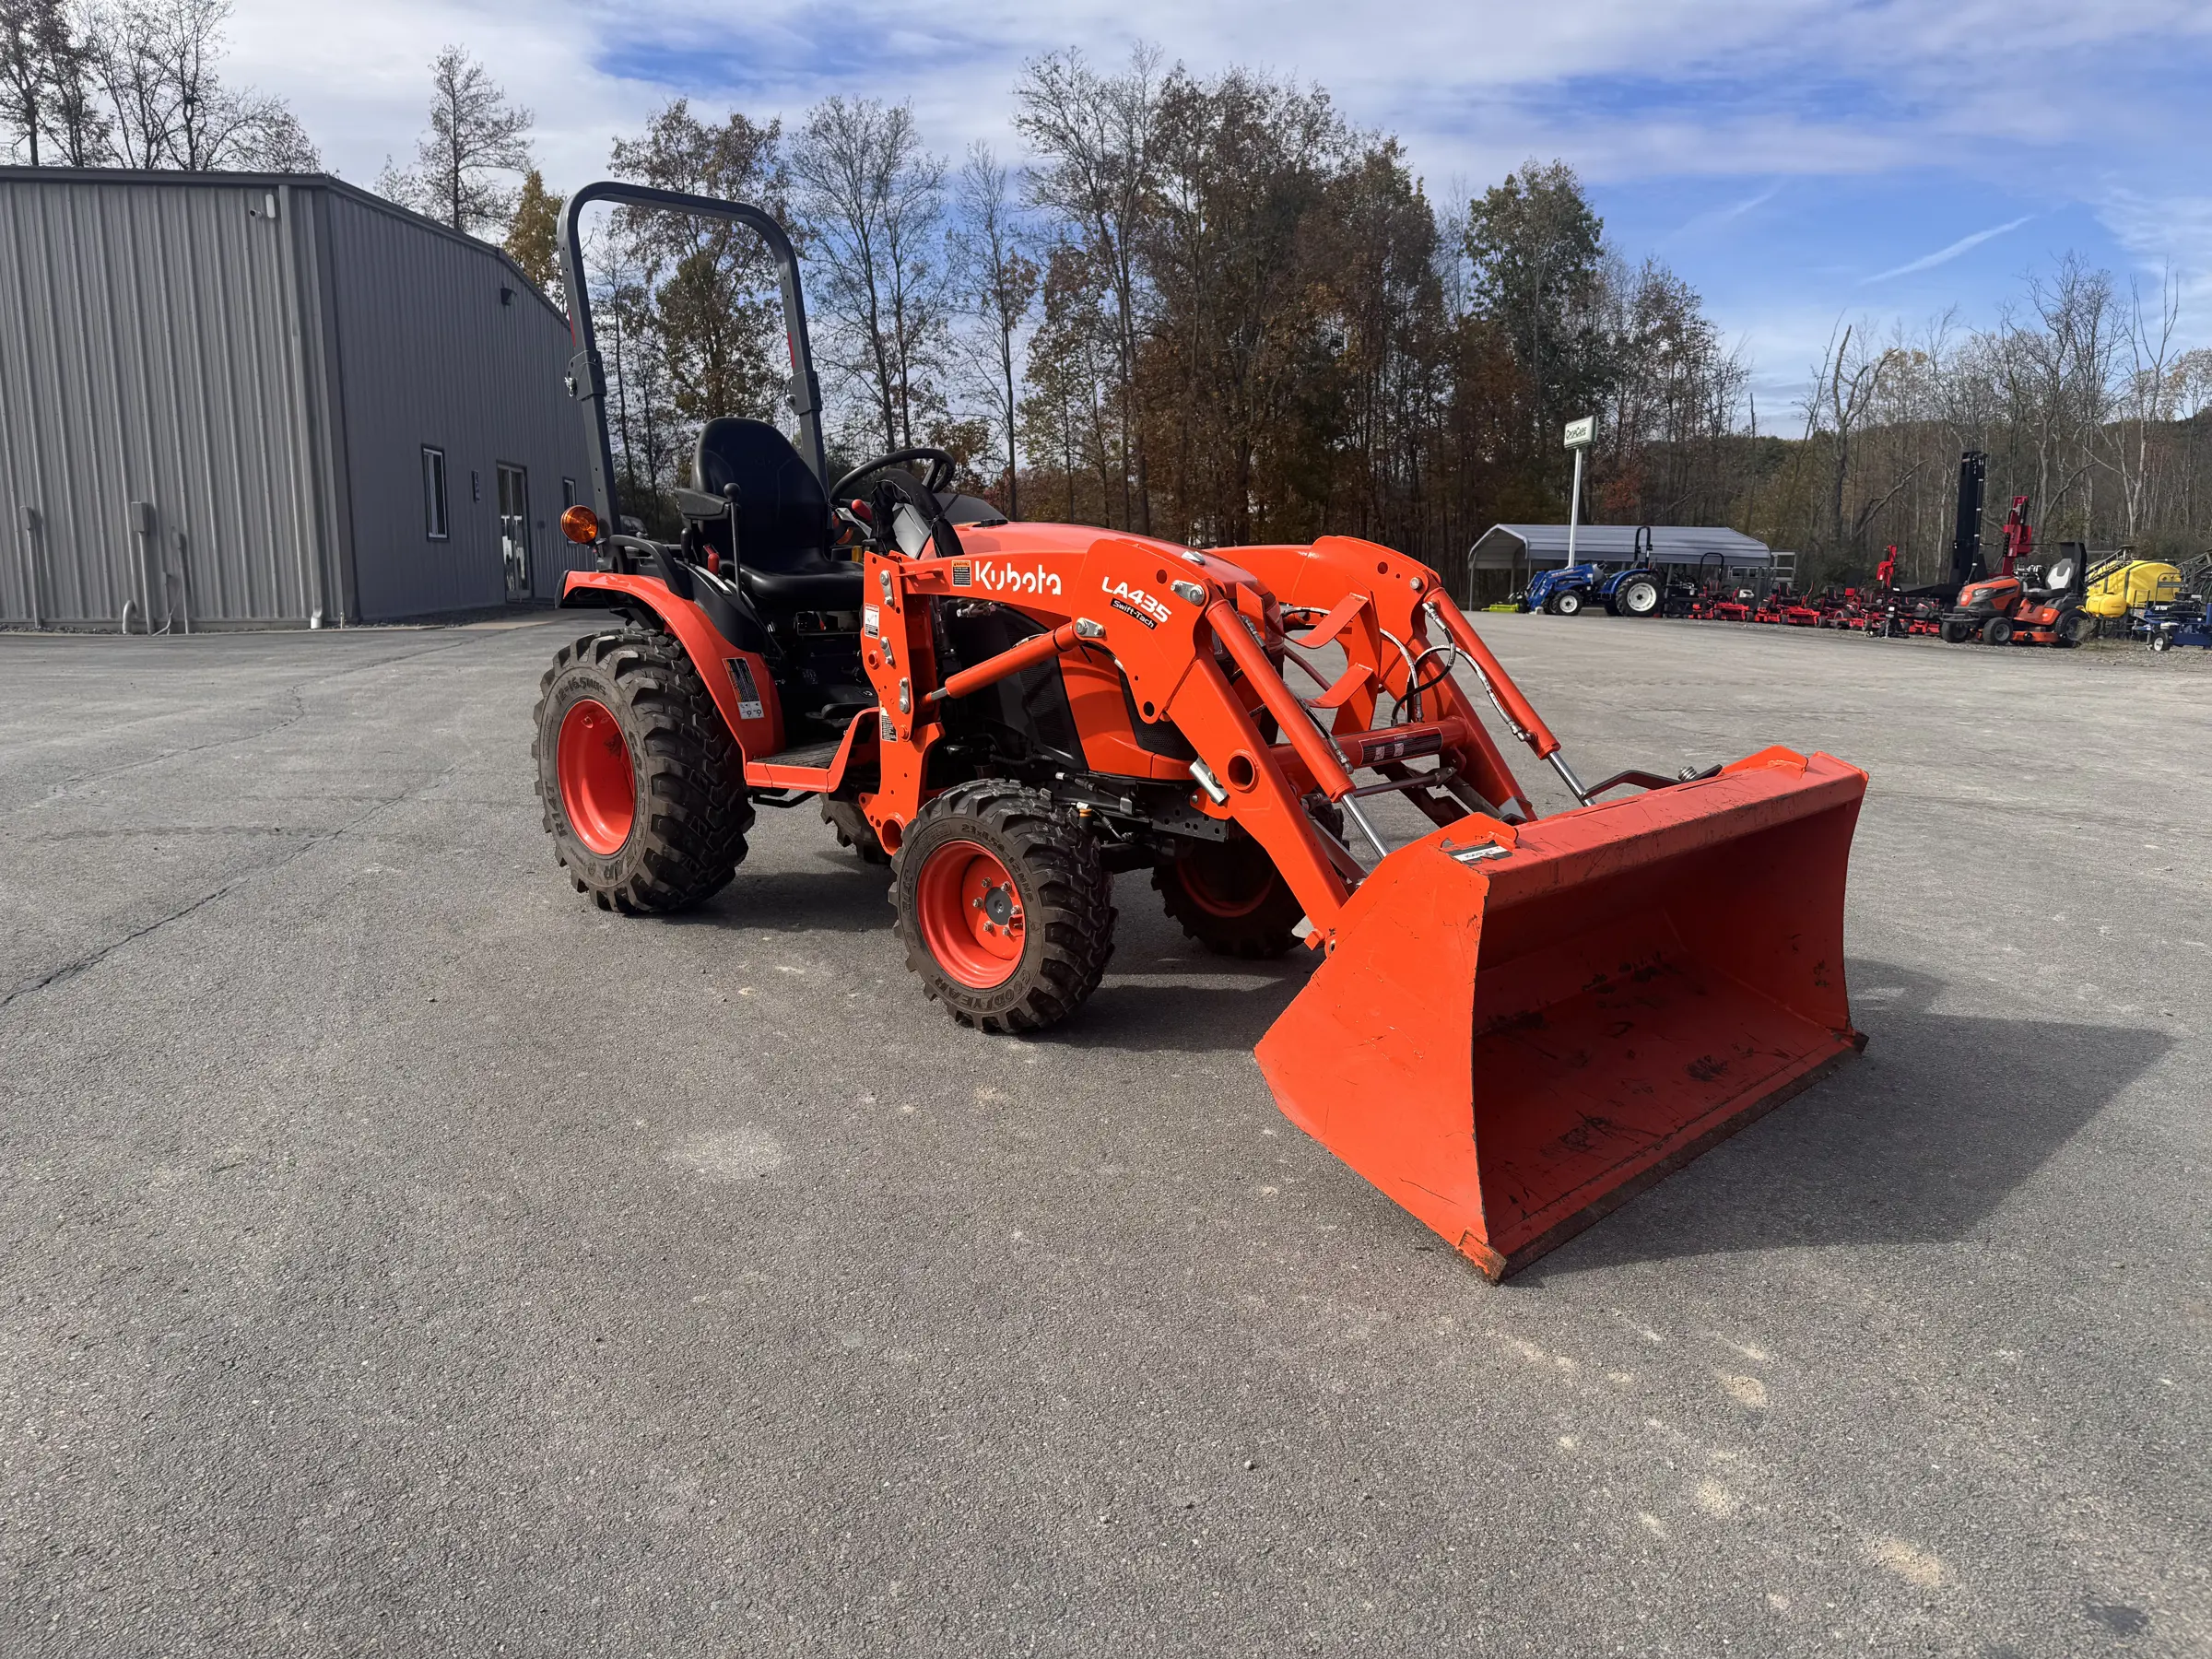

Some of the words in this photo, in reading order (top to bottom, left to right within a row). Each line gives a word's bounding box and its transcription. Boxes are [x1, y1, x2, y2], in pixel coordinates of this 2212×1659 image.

[975, 560, 1062, 595] Kubota
[1101, 576, 1172, 623] LA435
[1112, 600, 1155, 629] Swift-Tach
[934, 968, 1030, 1010] GOODYEAR
